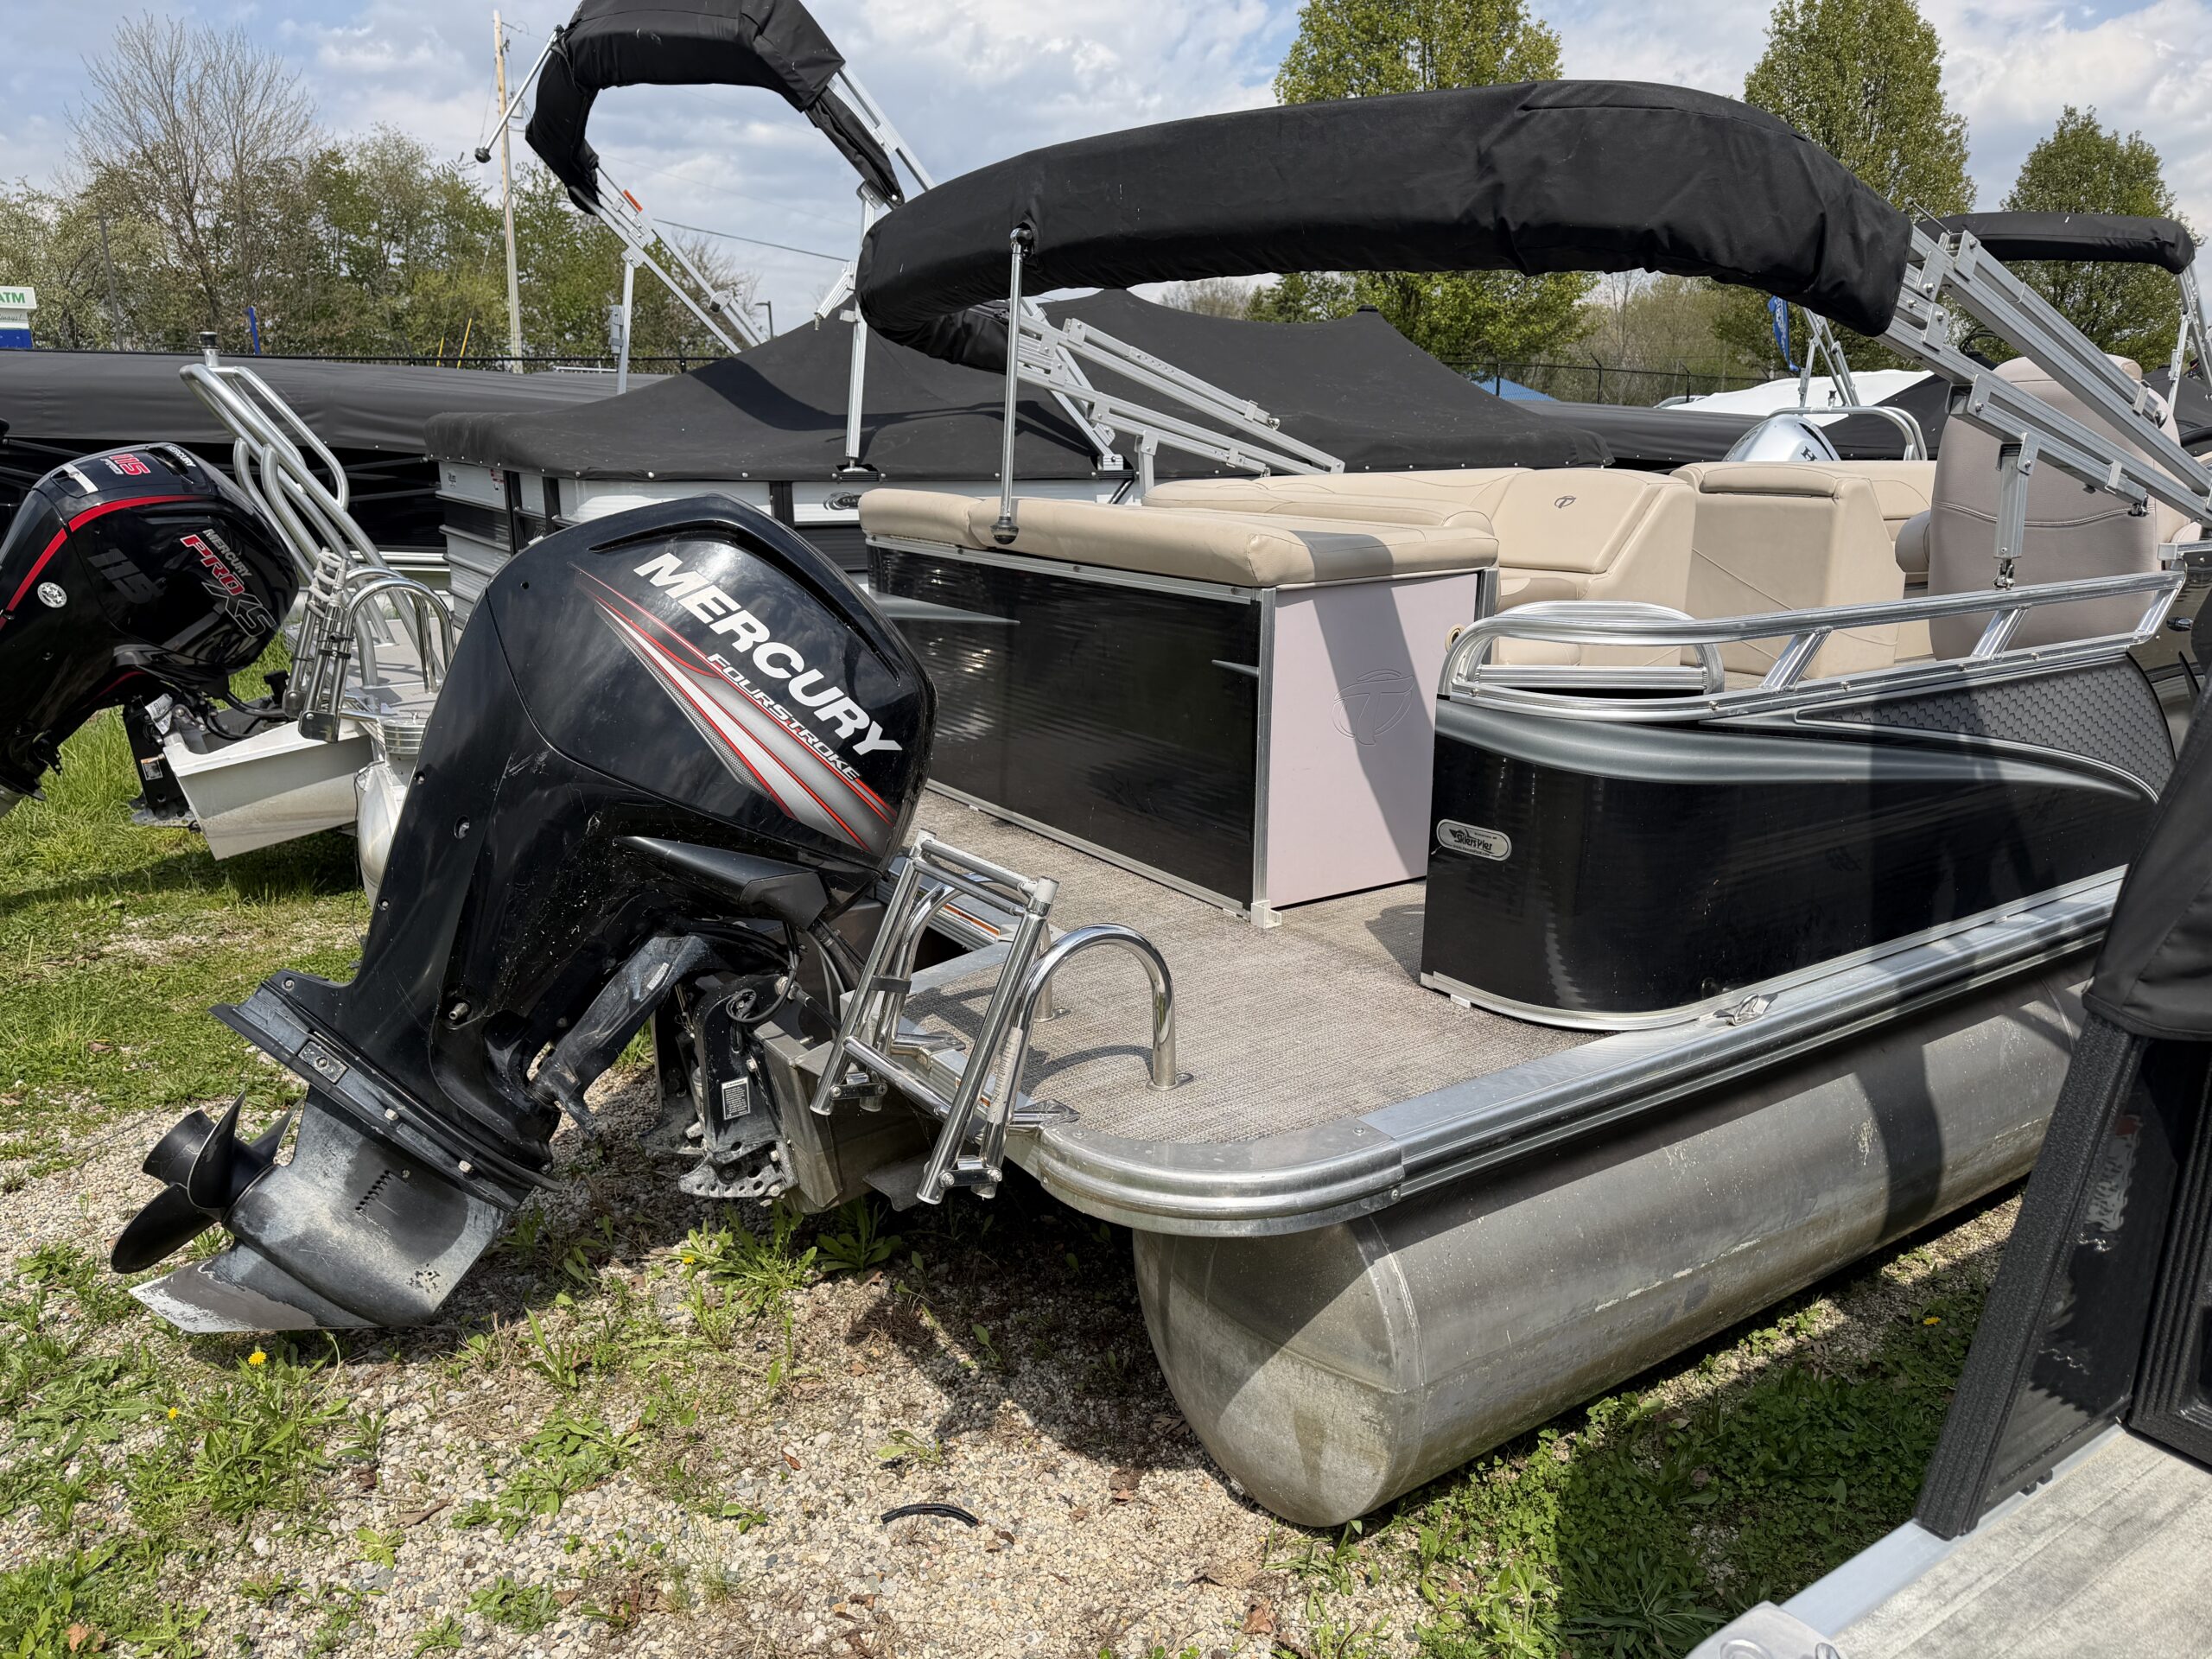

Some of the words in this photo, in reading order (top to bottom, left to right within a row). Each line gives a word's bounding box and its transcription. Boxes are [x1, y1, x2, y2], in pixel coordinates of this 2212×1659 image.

[109, 454, 151, 475] 115
[165, 445, 196, 467] MERCURY
[87, 548, 166, 604] 115
[180, 534, 245, 595] PRO
[202, 529, 252, 577] MERCURY
[201, 572, 276, 637] XS
[633, 552, 903, 756] MERCURY
[707, 653, 861, 780] FOURSTROKE
